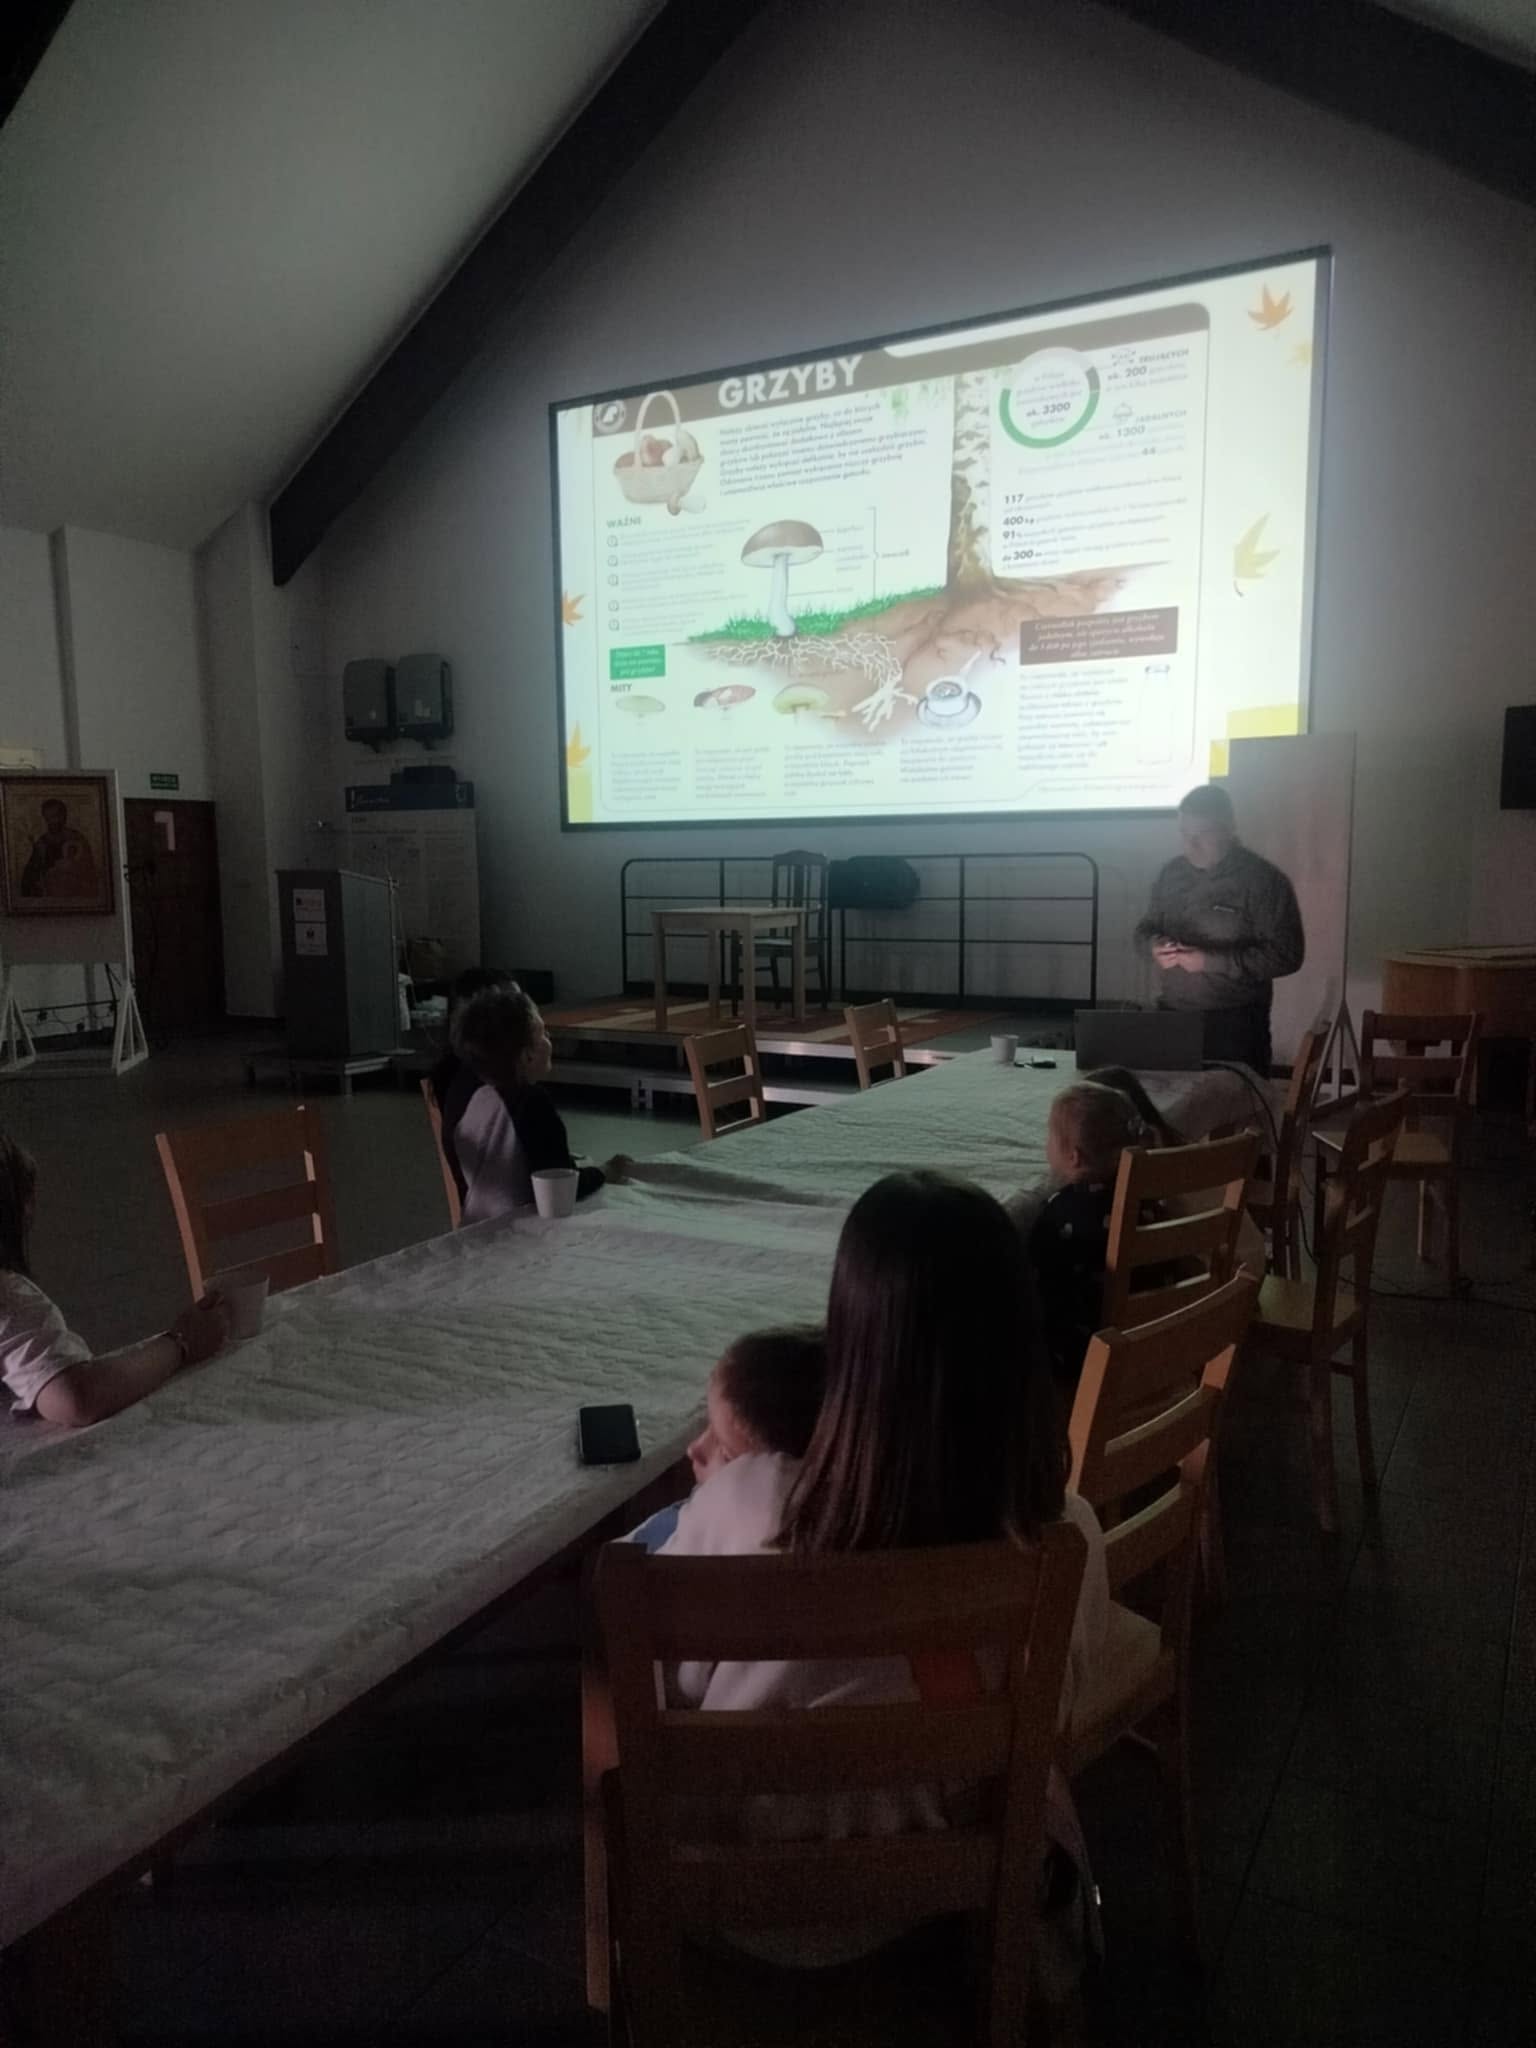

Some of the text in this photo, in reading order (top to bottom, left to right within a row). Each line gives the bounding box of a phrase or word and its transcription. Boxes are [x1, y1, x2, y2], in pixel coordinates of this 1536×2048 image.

[1125, 366, 1147, 378] 200
[718, 354, 863, 409] GRZYBY
[1042, 401, 1071, 415] 3300
[1004, 493, 1024, 504] 117
[1003, 515, 1023, 527] 400
[1013, 549, 1034, 561] 300
